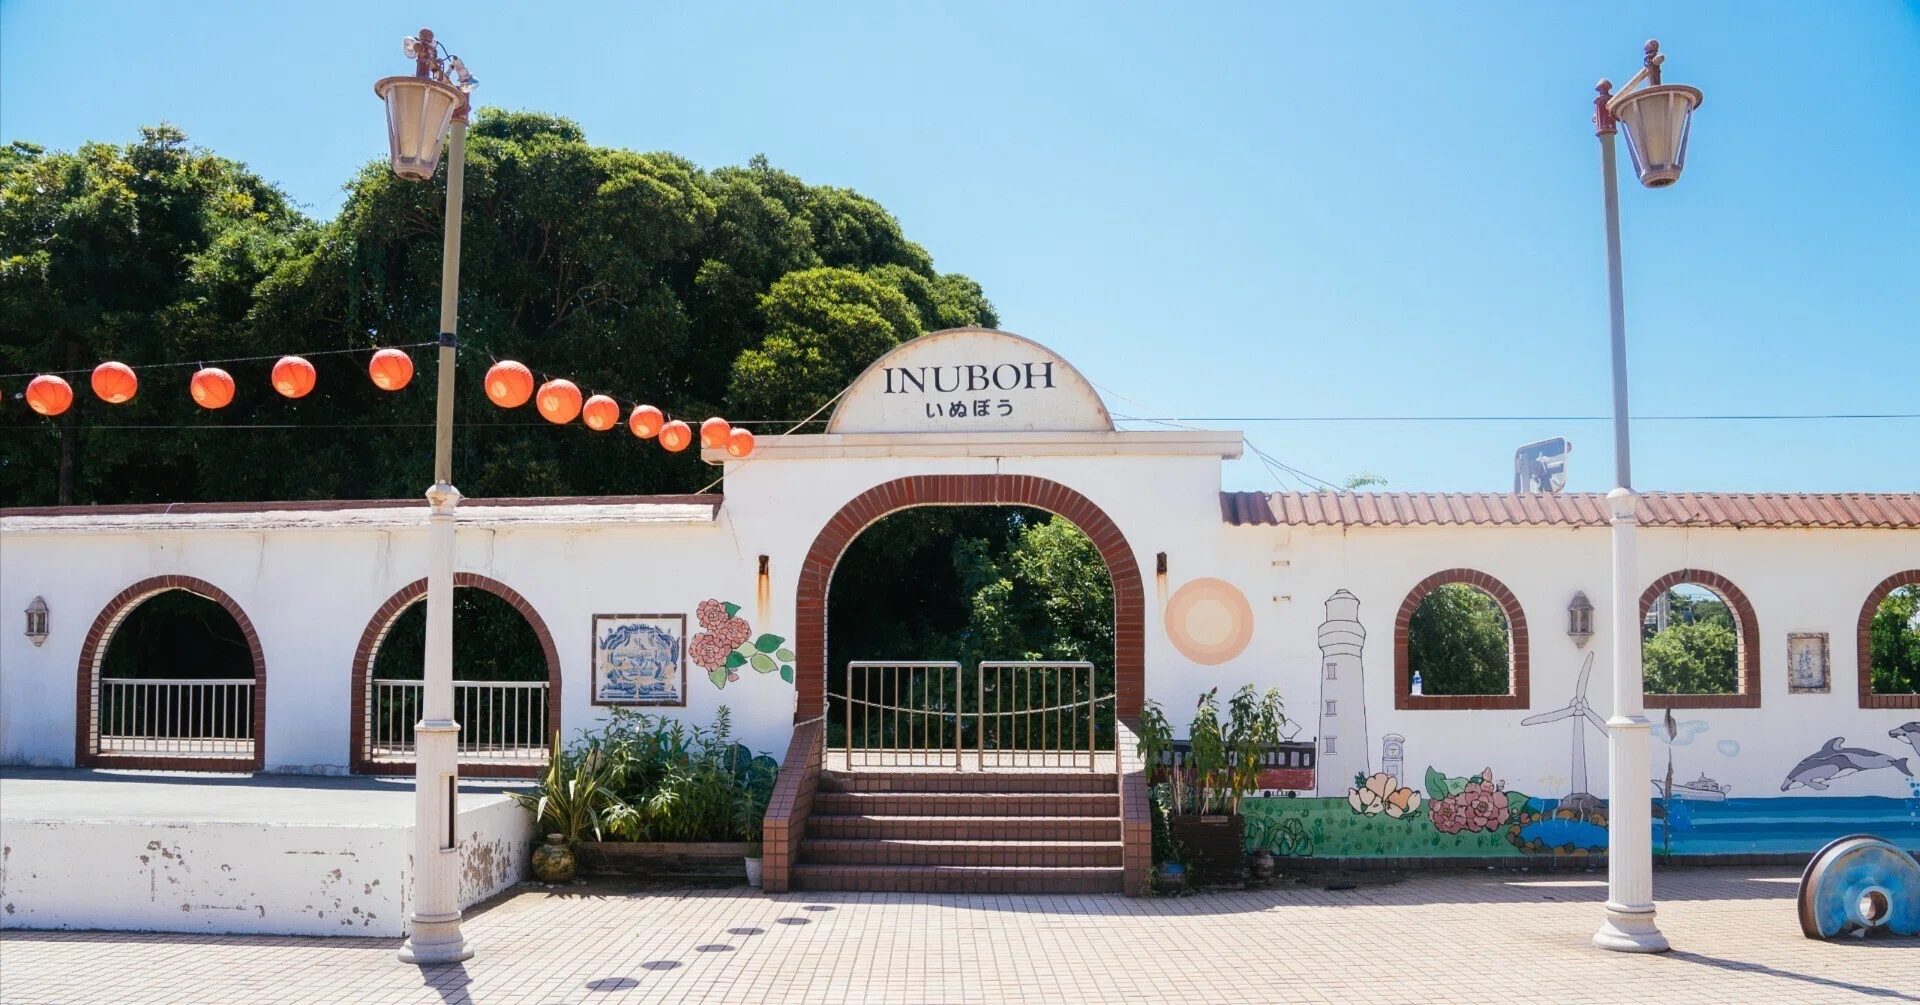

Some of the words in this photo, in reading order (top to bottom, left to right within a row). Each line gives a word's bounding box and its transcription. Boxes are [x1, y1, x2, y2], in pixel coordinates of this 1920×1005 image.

[883, 361, 1056, 394] INUBOH
[925, 398, 1013, 418] いぬぼう
